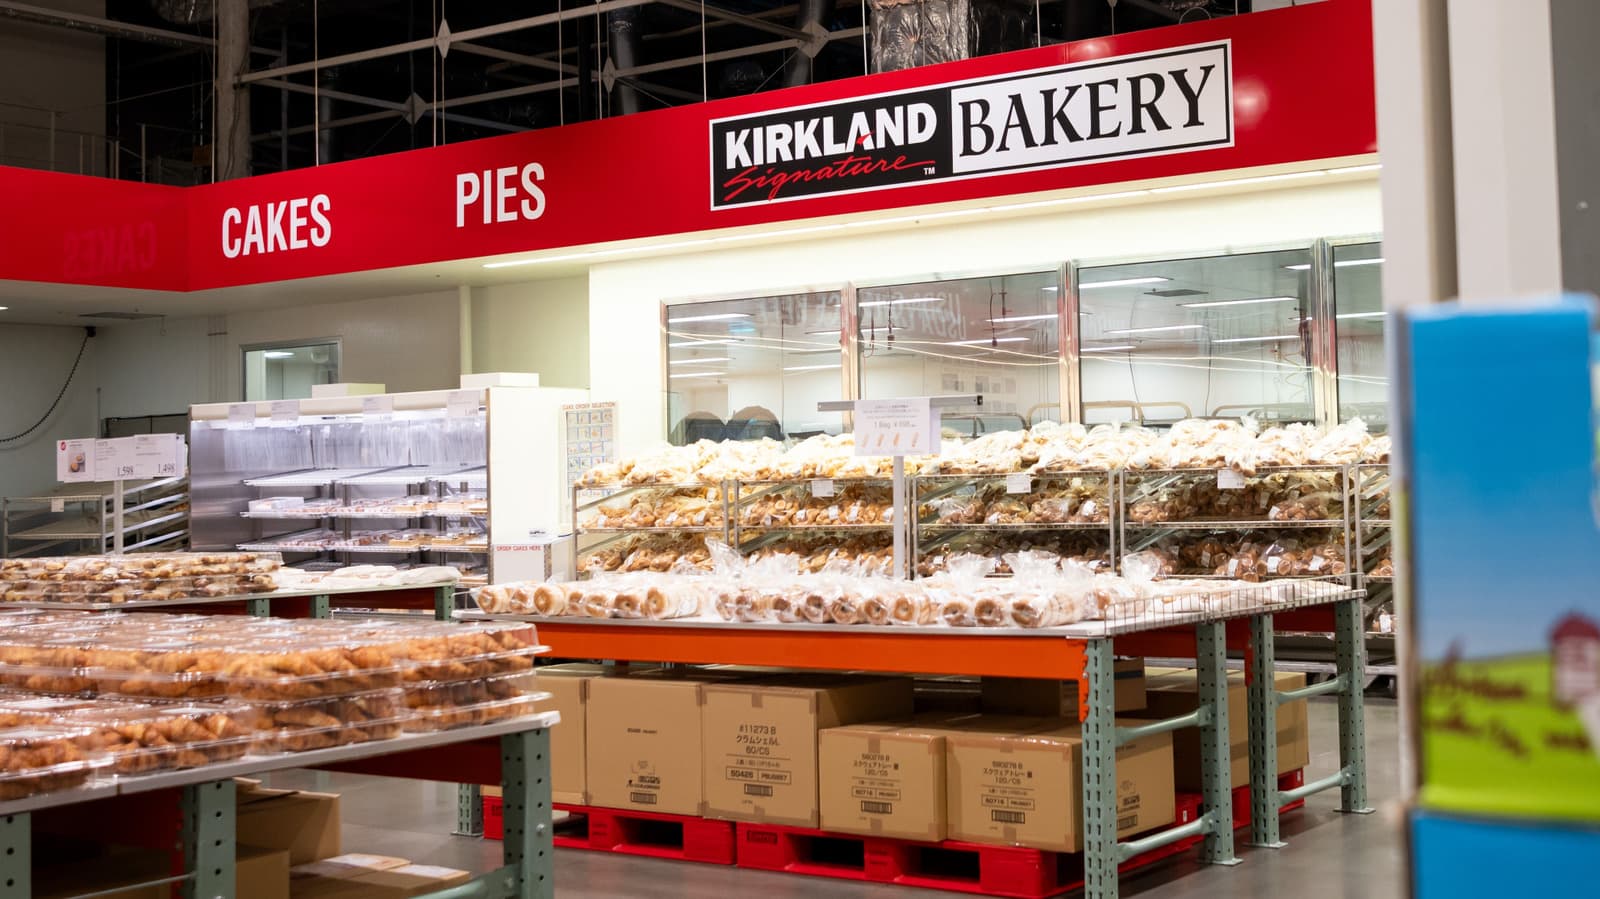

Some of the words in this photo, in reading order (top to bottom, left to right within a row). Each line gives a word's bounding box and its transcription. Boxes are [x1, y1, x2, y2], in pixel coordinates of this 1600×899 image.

[725, 102, 938, 169] KIRKLAND
[957, 64, 1216, 157] BAKERY
[455, 162, 547, 228] PIES
[723, 154, 935, 201] Signature
[221, 194, 332, 259] CAKES
